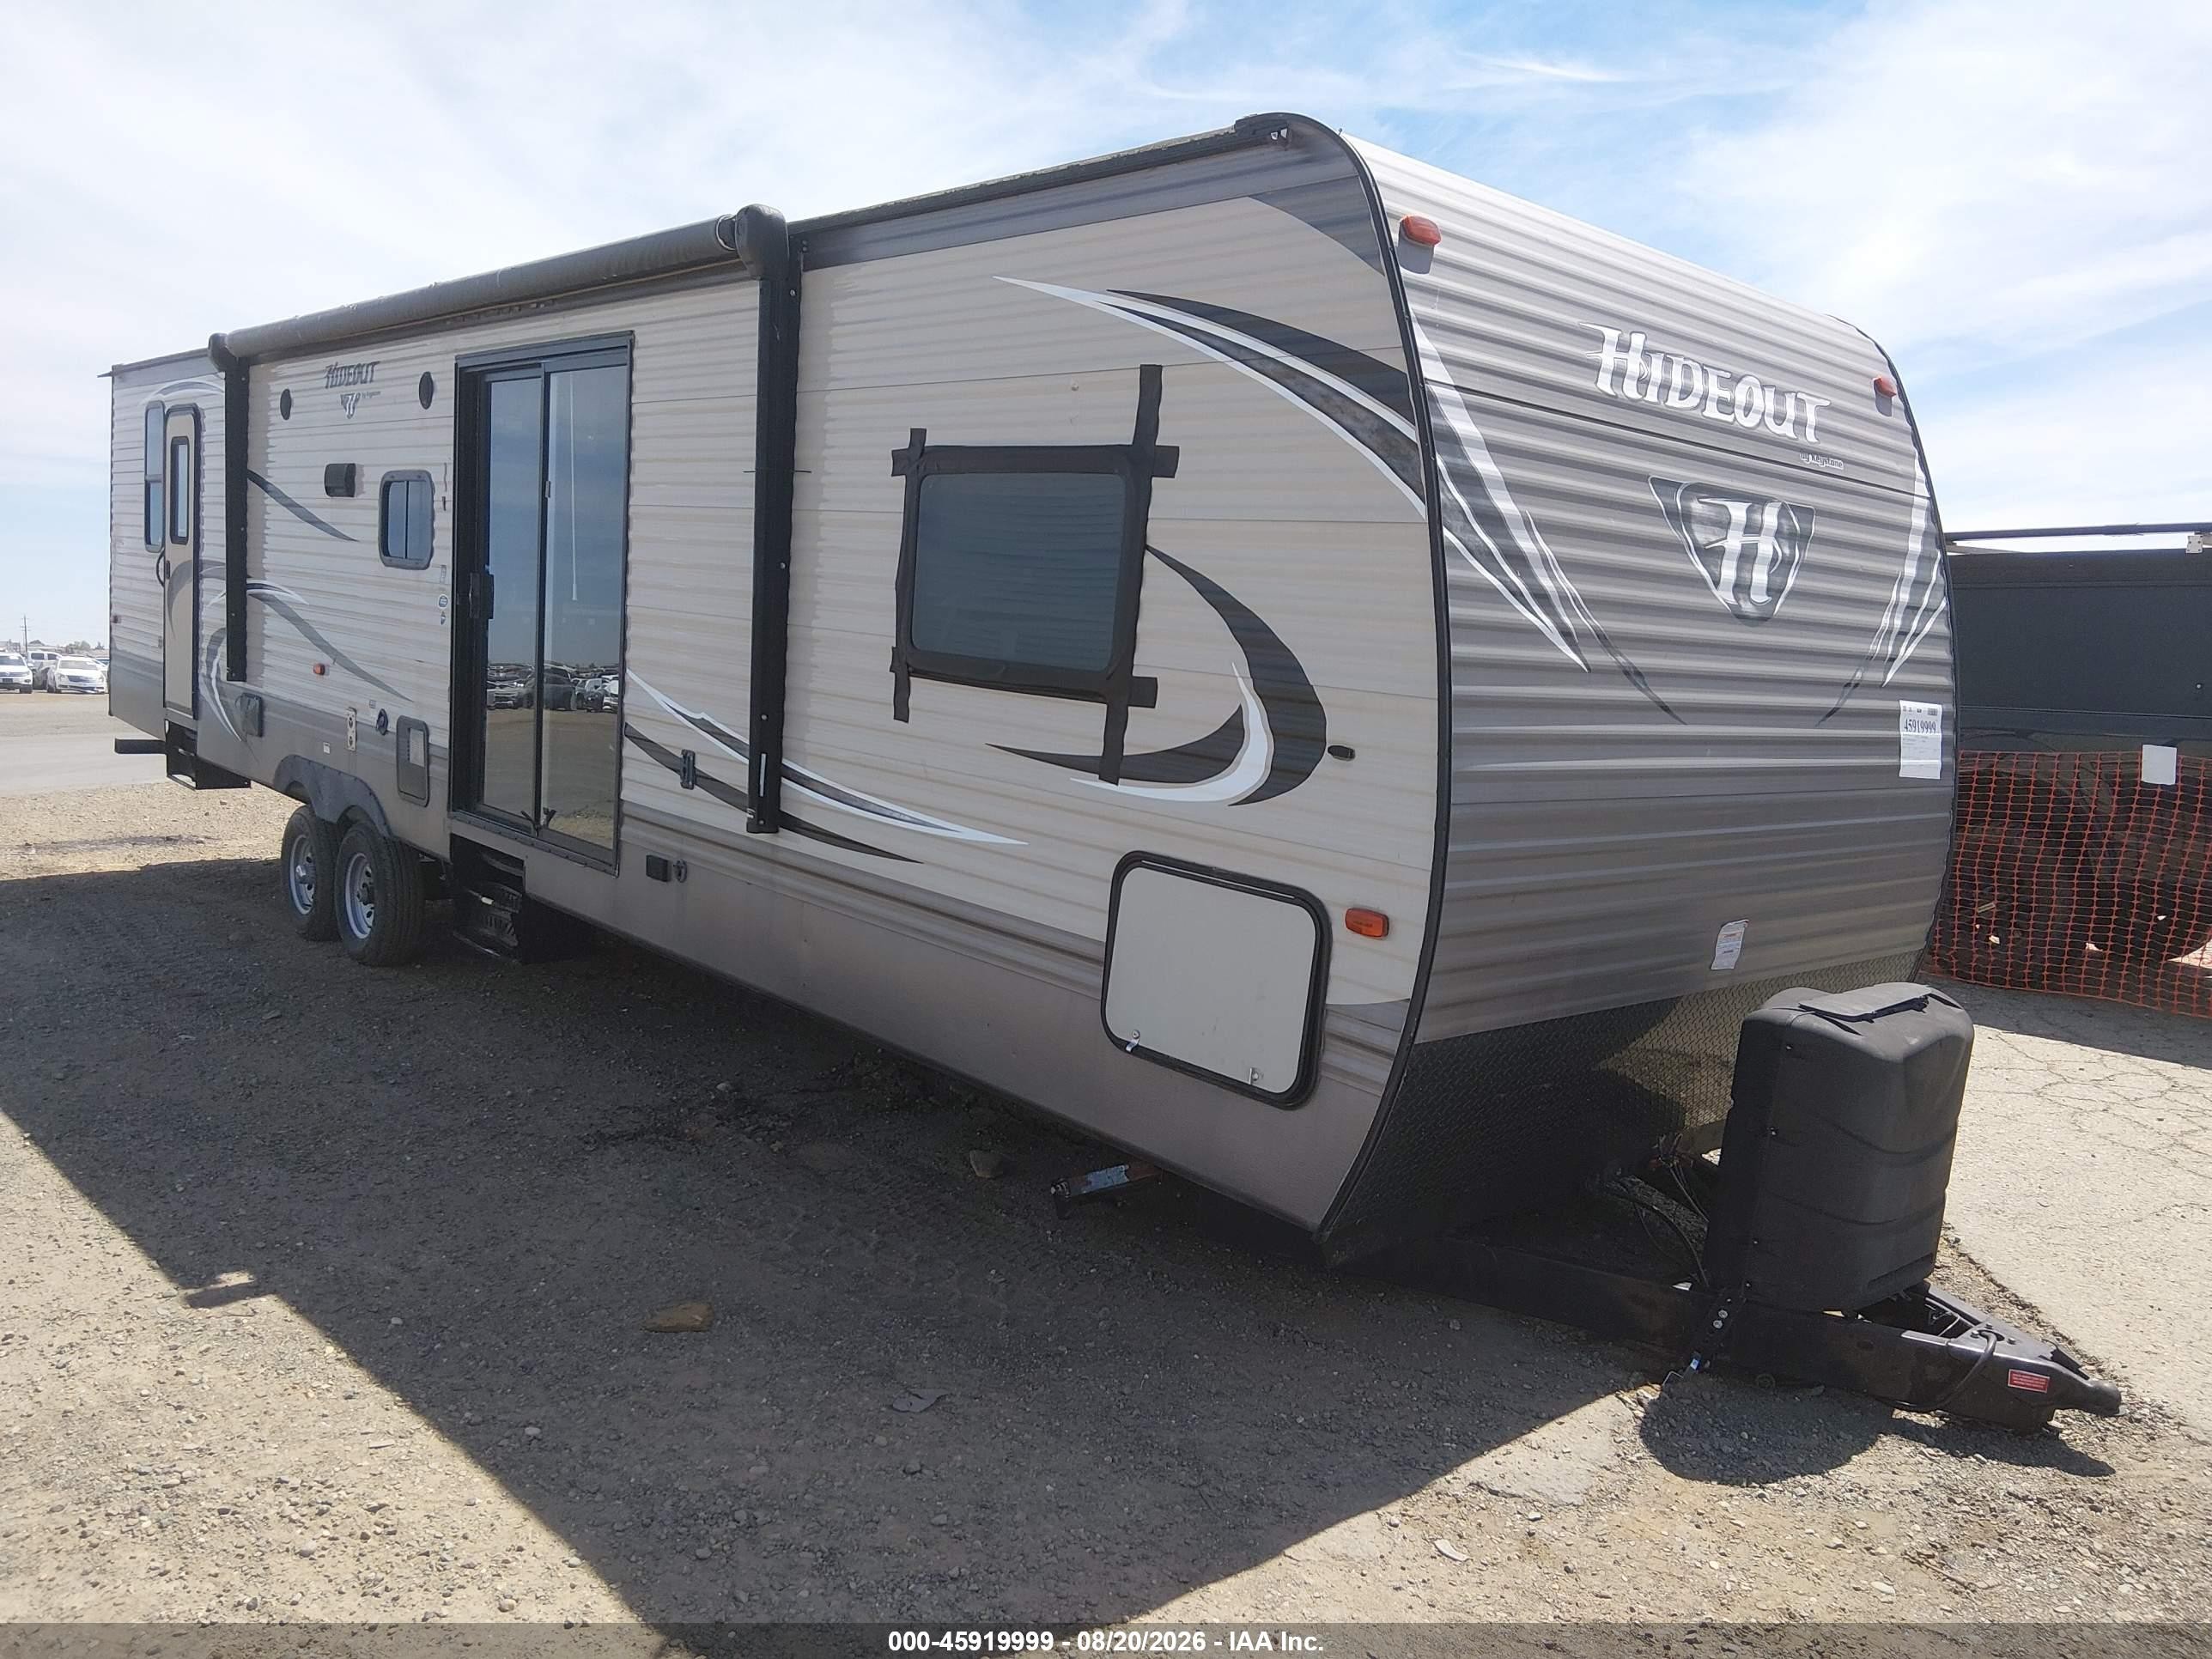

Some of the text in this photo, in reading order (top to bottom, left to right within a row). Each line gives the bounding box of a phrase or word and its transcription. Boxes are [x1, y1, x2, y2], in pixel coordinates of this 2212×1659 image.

[325, 361, 380, 389] HIDEOUT
[1579, 322, 1832, 443] HIDEOUT
[1904, 718, 1936, 733] 45919999
